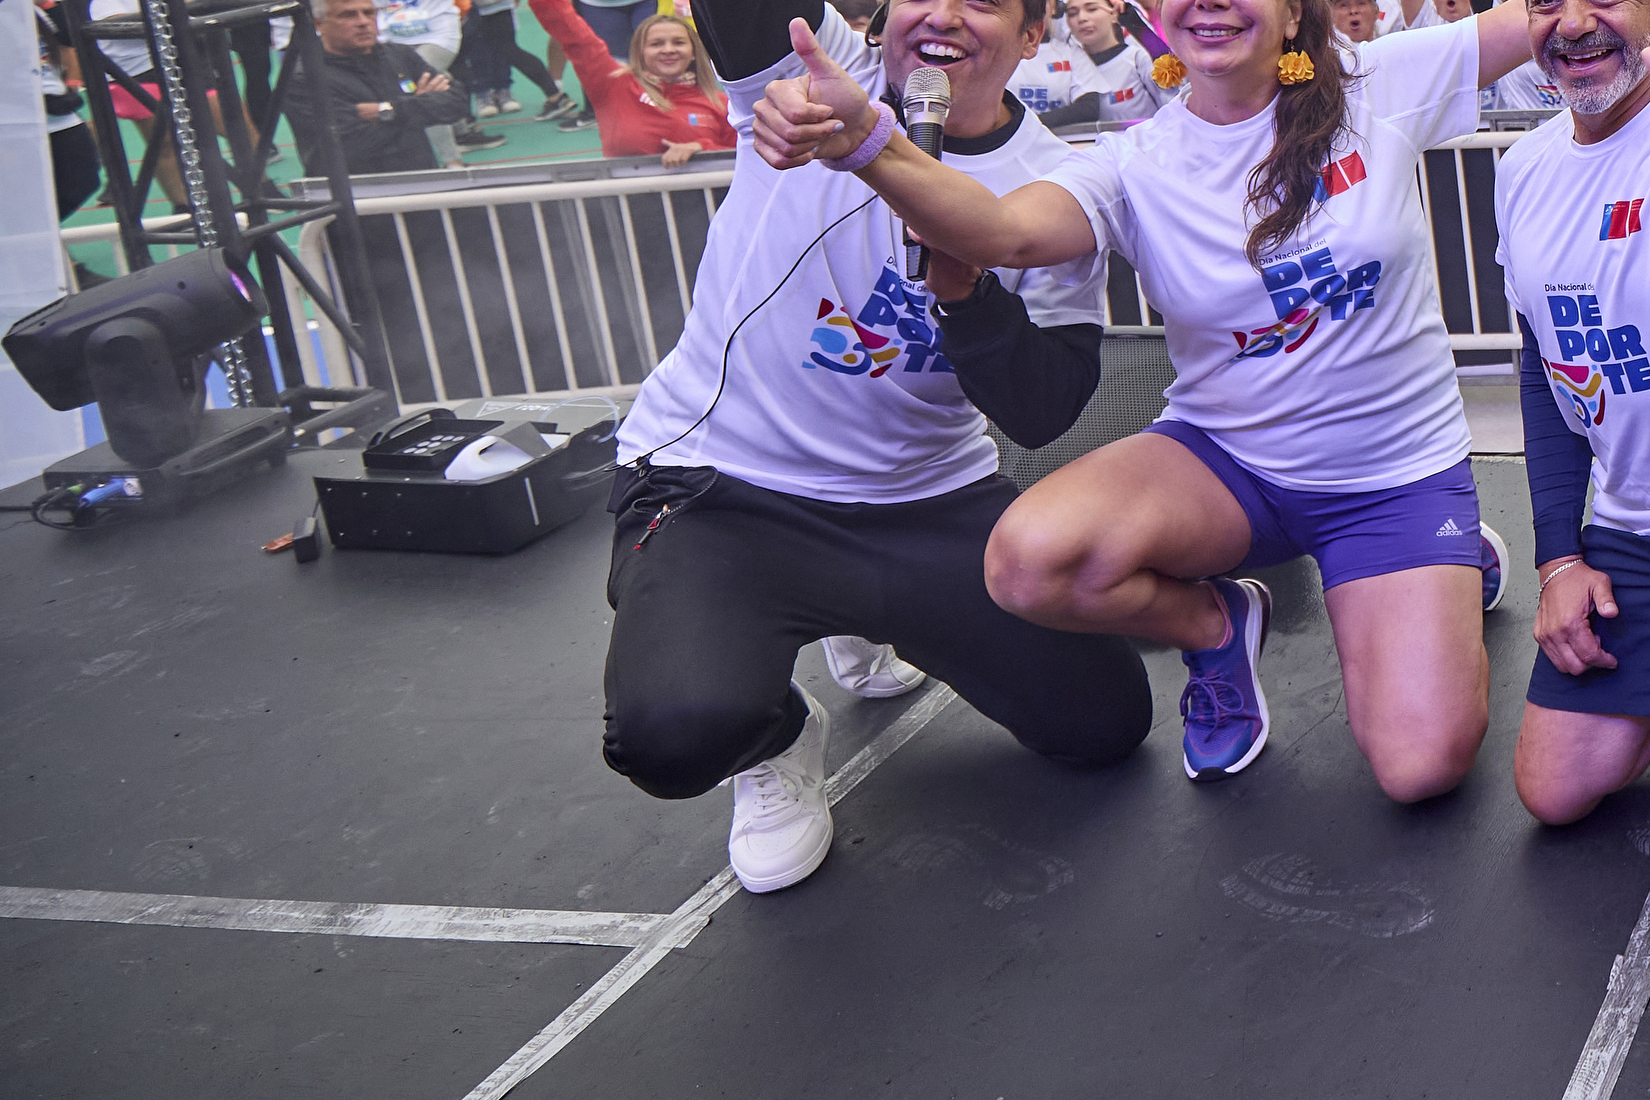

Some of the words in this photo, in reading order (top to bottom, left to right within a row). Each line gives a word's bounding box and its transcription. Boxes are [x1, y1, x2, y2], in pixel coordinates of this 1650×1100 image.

[1019, 88, 1048, 99] DE
[1274, 243, 1313, 261] Nacional
[1313, 238, 1327, 249] del
[1262, 247, 1336, 292] DE
[1270, 260, 1383, 320] POR
[1544, 283, 1557, 292] Día
[1557, 283, 1587, 291] Nacional
[1323, 289, 1376, 321] TE
[1547, 294, 1603, 328] DE
[1555, 324, 1644, 362] POR
